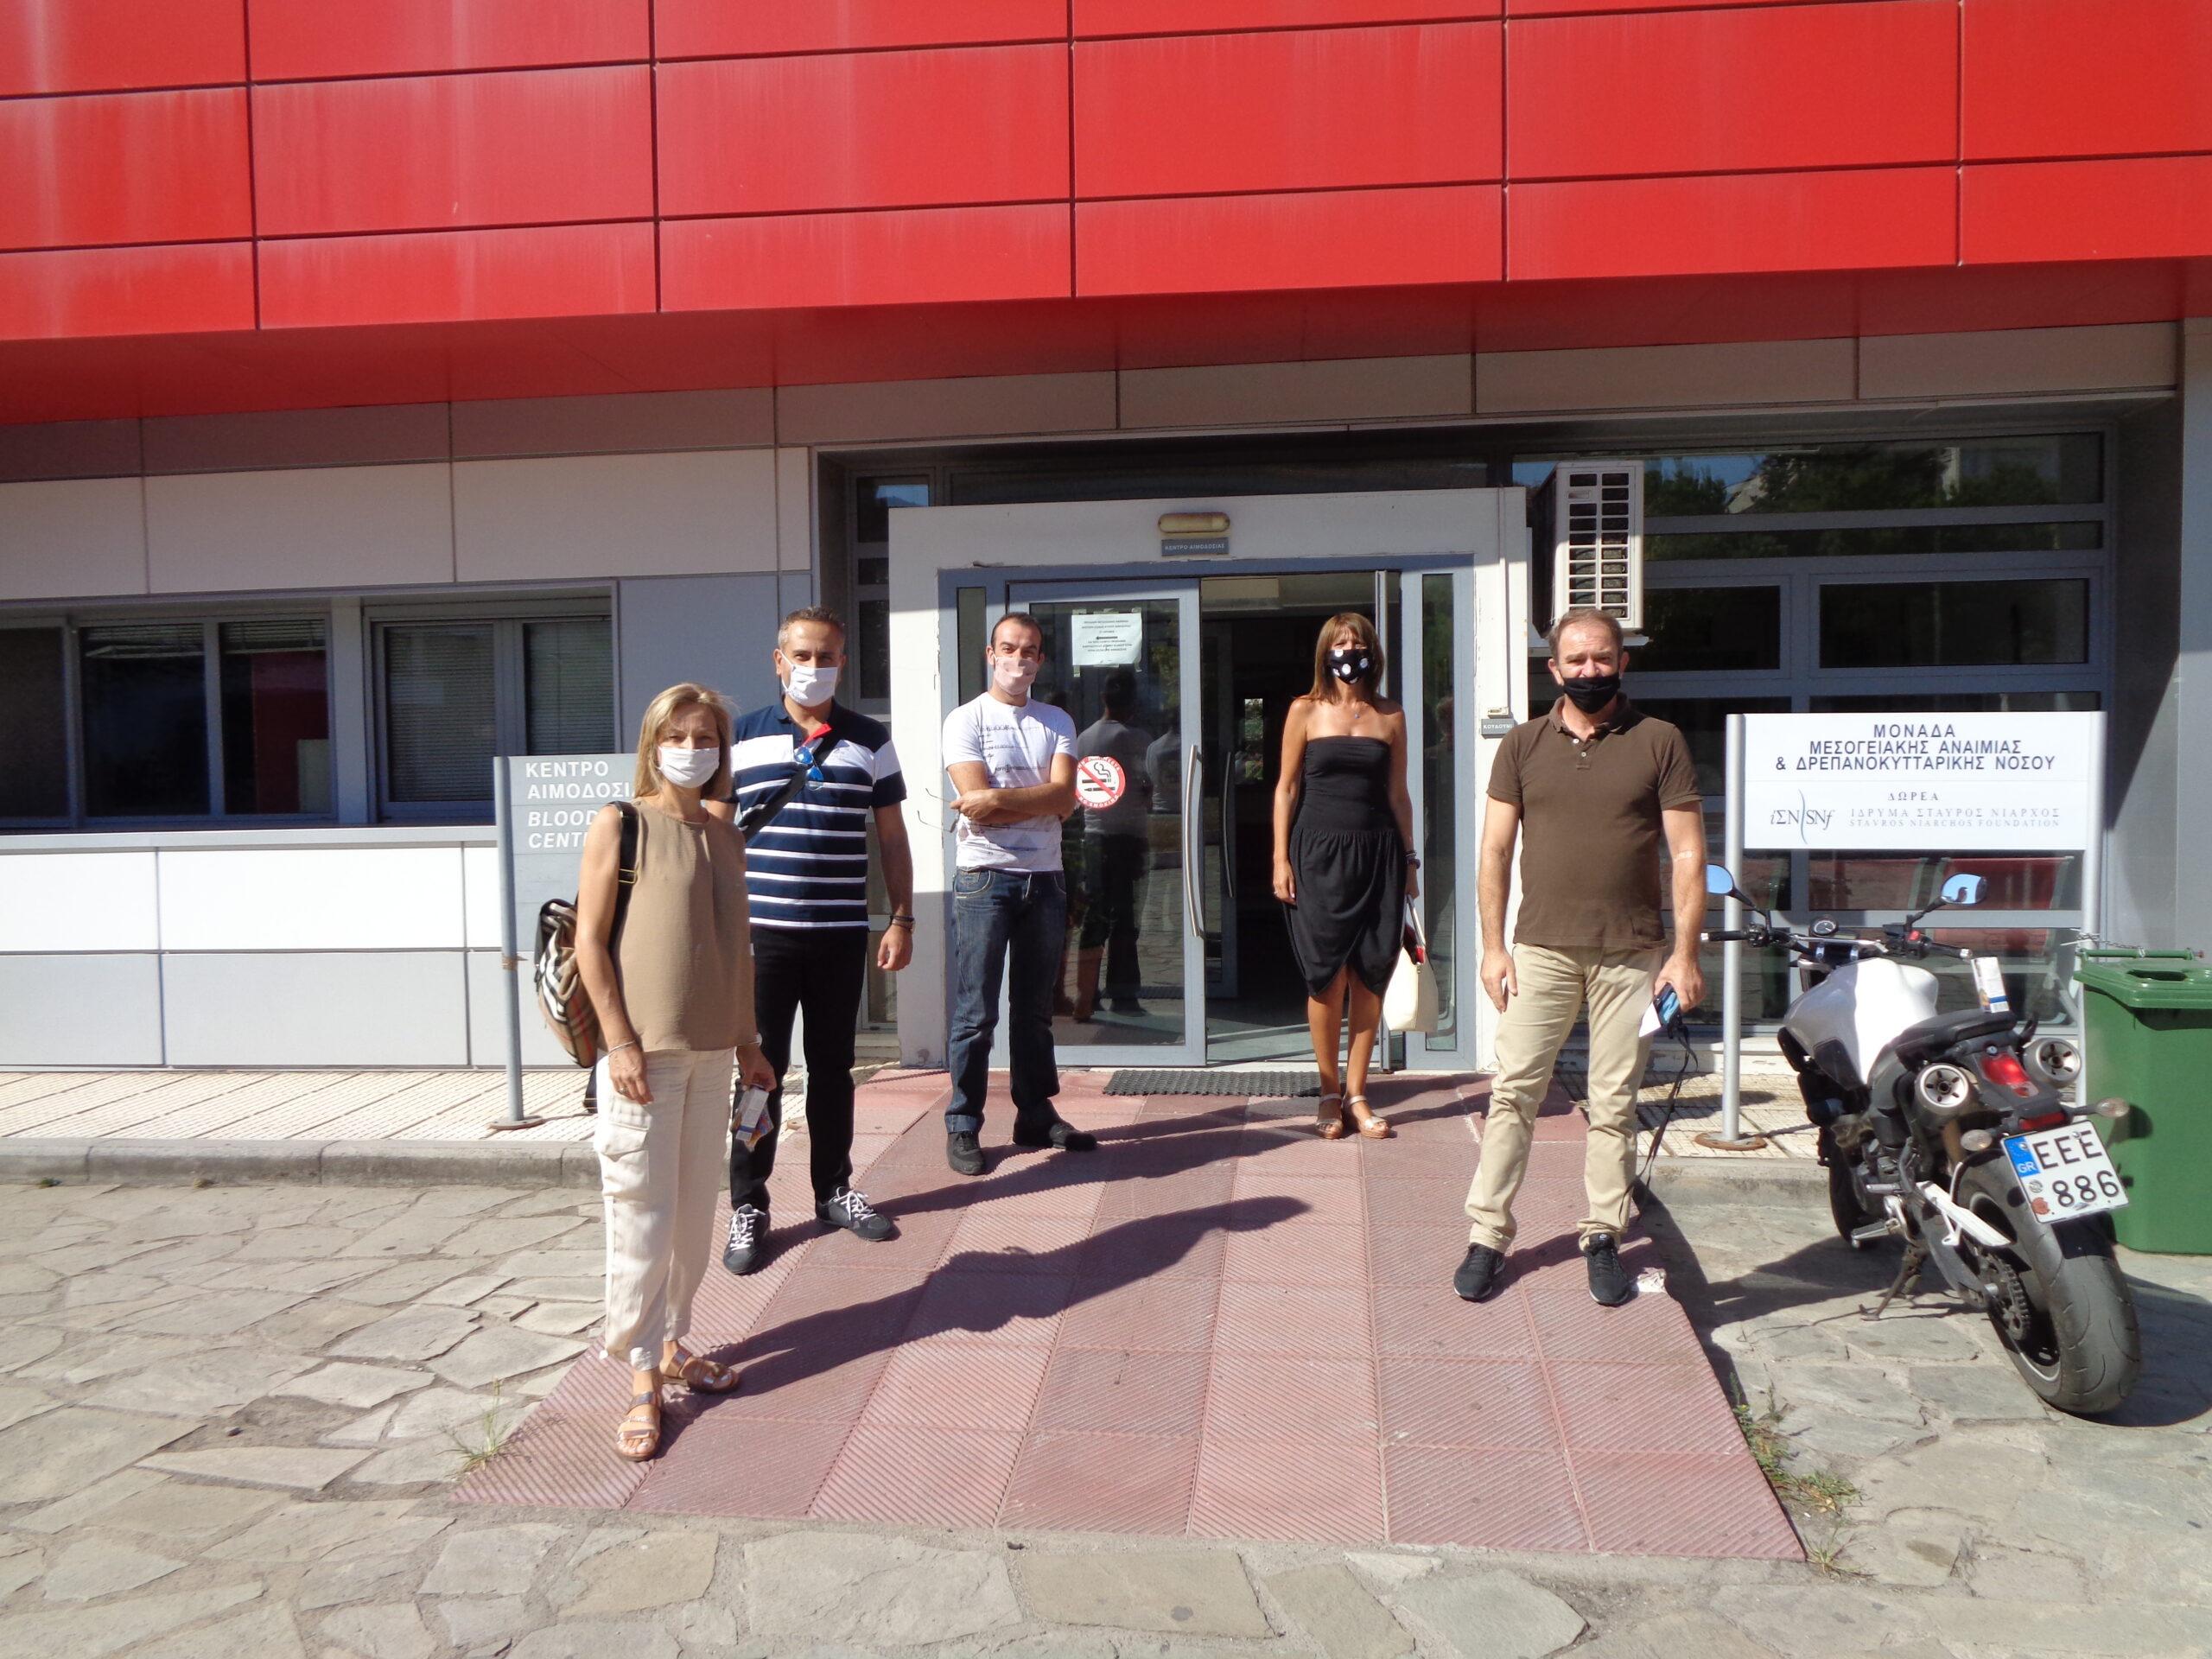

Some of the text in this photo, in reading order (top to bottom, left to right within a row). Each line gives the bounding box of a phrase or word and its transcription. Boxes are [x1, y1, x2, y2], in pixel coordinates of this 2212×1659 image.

[1873, 724, 1956, 738] ΜΟΝΑΔΑ
[1809, 740, 2021, 754] ΜΕΣΟΓΕΙΑΚΗΣ ΑΝΑΙΜΙΑΣ
[525, 760, 609, 778] ΚΕΝΤΡΟ
[1776, 756, 2055, 770] & ΔΡΕΠΑΝΟΚΥΤΤΑΡΙΚΗΣ ΝΟΣΟΥ
[527, 782, 635, 799] ΑΙΜΟΔΟΣΙ
[1888, 791, 1939, 801] ΔΩΡΕΑ
[528, 810, 599, 827] BLOOD
[1851, 808, 2060, 817] ΙΔΡΥΜΑ ΣΤΑΥΡΟΣ ΝΙΑΡΧΟΣ
[2032, 1130, 2102, 1169] EEE
[2017, 1161, 2036, 1173] GR
[2052, 1170, 2119, 1207] 886
